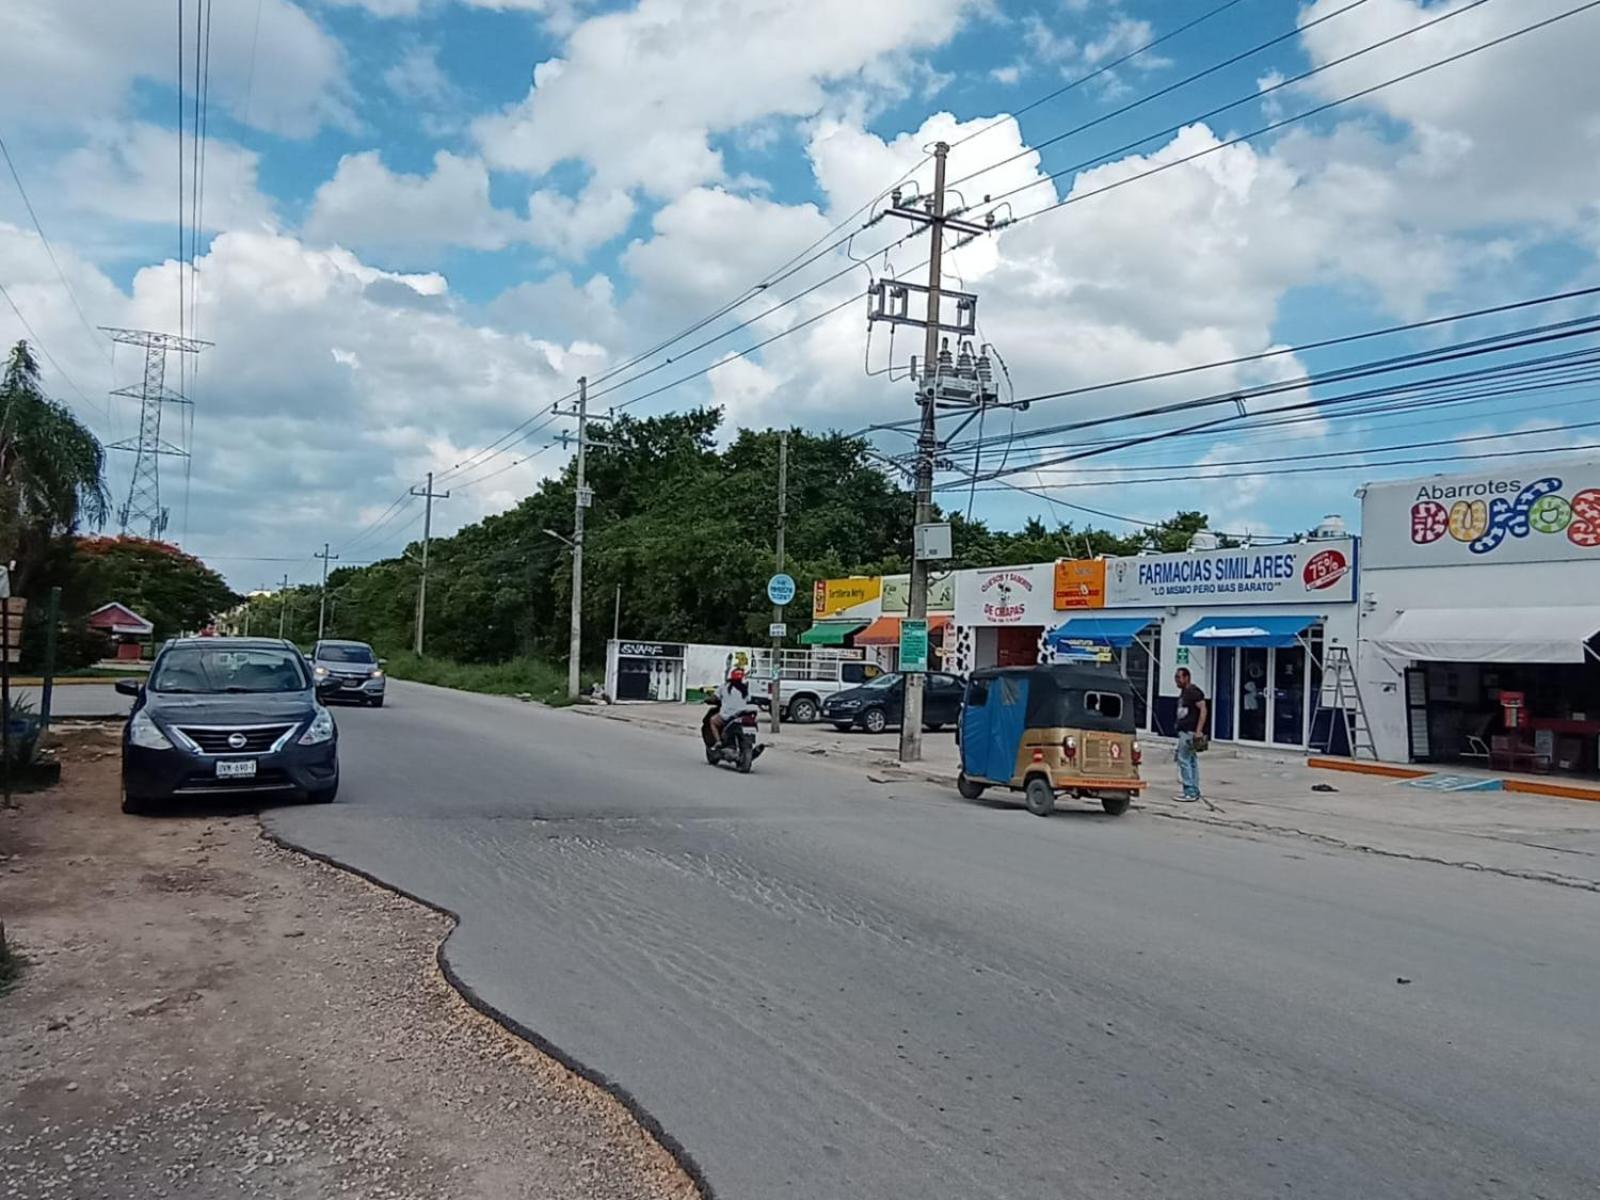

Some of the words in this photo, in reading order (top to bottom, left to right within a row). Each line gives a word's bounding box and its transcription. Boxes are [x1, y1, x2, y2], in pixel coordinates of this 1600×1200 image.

[1416, 480, 1521, 501] Abarrotes
[1138, 560, 1212, 585] FARMACIAS
[1215, 554, 1294, 580] SIMILARES
[1308, 555, 1339, 580] 75%
[1166, 585, 1191, 595] MISMO
[1193, 584, 1215, 593] PERO
